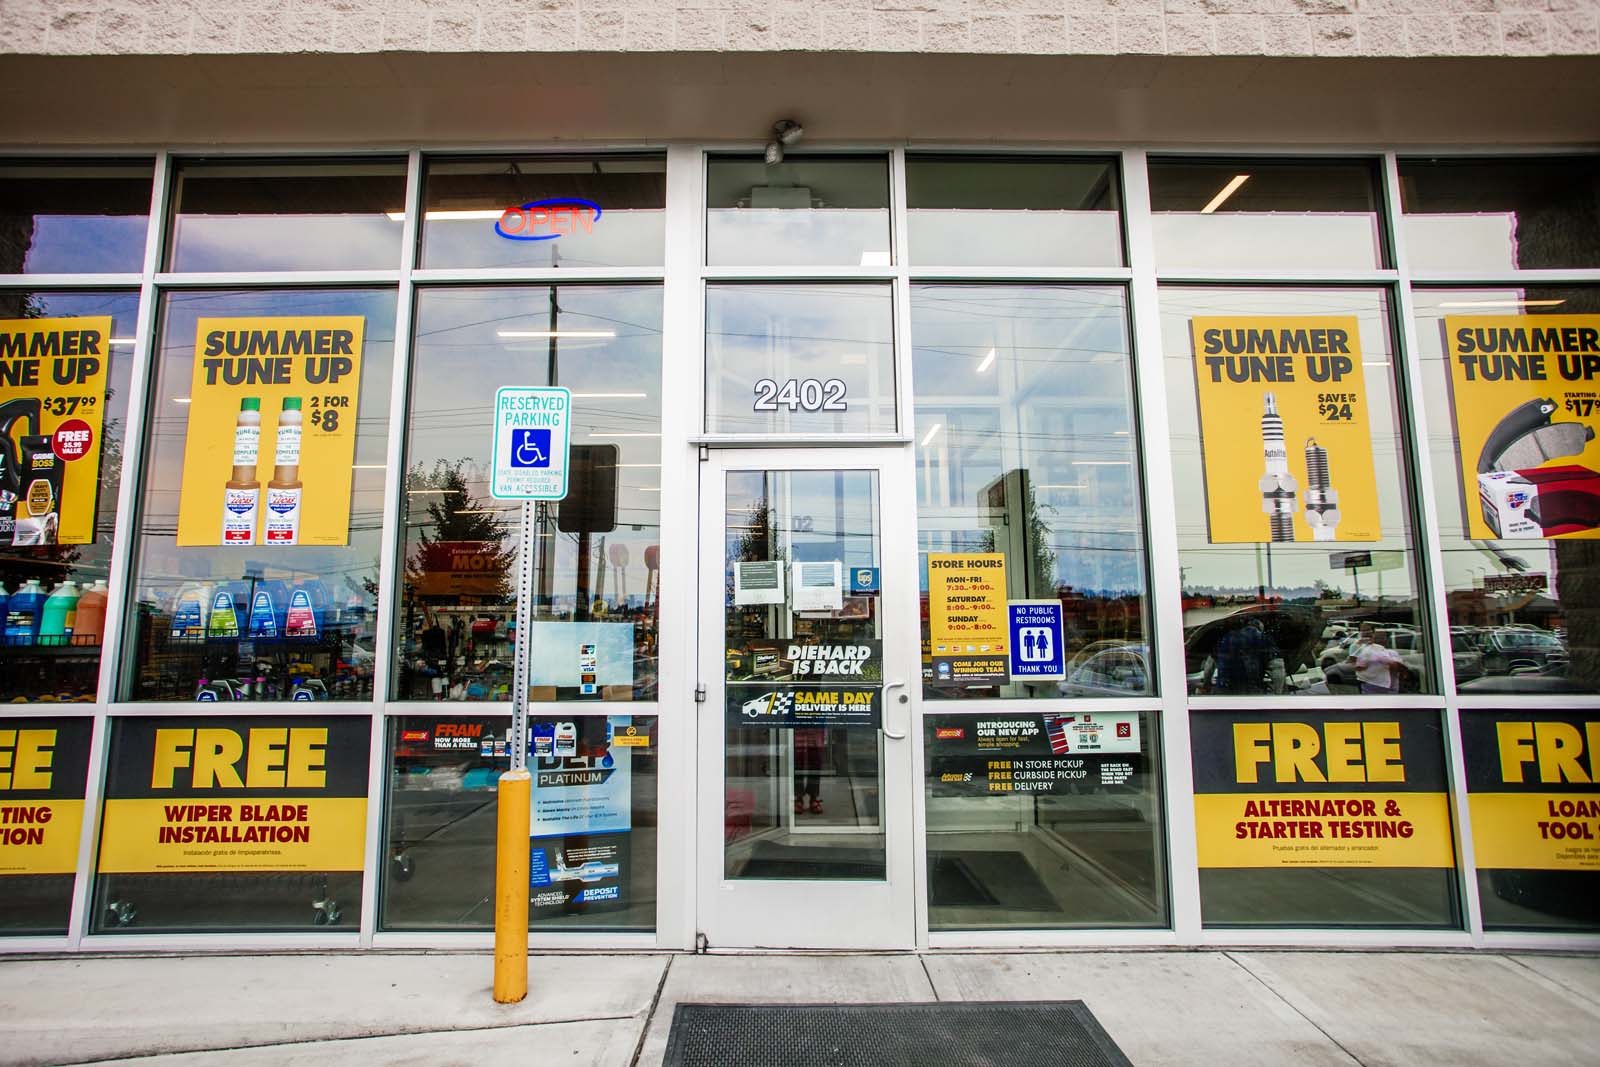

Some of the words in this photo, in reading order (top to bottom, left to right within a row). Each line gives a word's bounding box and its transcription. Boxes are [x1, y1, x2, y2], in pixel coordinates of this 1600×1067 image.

[500, 207, 593, 234] OPEN
[204, 330, 354, 356] SUMMER
[1204, 329, 1350, 354] SUMMER
[1457, 328, 1600, 353] SUMMER
[53, 358, 100, 384] UP
[203, 357, 292, 385] TUNE
[305, 357, 353, 384] UP
[1205, 356, 1295, 383] TUNE
[1306, 356, 1352, 382] UP
[1459, 355, 1547, 381] TUNE
[1559, 355, 1600, 381] UP
[311, 396, 320, 407] 2
[323, 396, 350, 407] FOR
[754, 379, 847, 411] 2402
[1318, 393, 1347, 402] SAVE
[501, 397, 564, 410] RESERVED
[505, 412, 560, 426] PARKING
[1318, 403, 1353, 421] $24
[311, 409, 339, 432] $8
[57, 430, 90, 443] FREE
[32, 459, 54, 467] BOSS
[516, 484, 558, 492] ACCESSIBLE
[931, 560, 964, 568] STORE
[967, 560, 1003, 568] HOURS
[1015, 616, 1056, 624] RESTROOMS
[787, 645, 871, 660] DIEHARD
[792, 660, 810, 674] IS
[813, 660, 865, 674] BACK
[1017, 665, 1040, 673] THANK
[1043, 665, 1058, 673] YOU
[795, 692, 838, 704] SAME
[843, 692, 874, 704] DAY
[434, 723, 482, 737] FRAM
[977, 721, 1035, 729] INTRODUCING
[152, 728, 328, 789] FREE
[1232, 722, 1405, 783] FREE
[988, 761, 1011, 769] FREE
[1013, 761, 1023, 769] IN
[1025, 760, 1052, 769] STORE
[1054, 760, 1084, 768] PICKUP
[540, 773, 602, 785] PLATINUM
[988, 771, 1012, 780] FREE
[1013, 771, 1055, 779] CURBSIDE
[1057, 770, 1087, 779] PICKUP
[988, 783, 1012, 791] FREE
[1014, 782, 1053, 790] DELIVERY
[164, 805, 233, 822] WIPER
[240, 804, 308, 822] BLADE
[1244, 800, 1377, 817] ALTERNATOR
[1384, 799, 1402, 817] &
[1, 807, 52, 824] TING
[0, 828, 44, 845] ION
[159, 826, 310, 844] INSTALLATION
[1235, 821, 1324, 839] STARTER
[1328, 821, 1414, 839] TESTING
[1538, 821, 1594, 840] TOOL
[583, 886, 618, 896] DEPOSIT
[583, 893, 618, 901] PREVENTION
[535, 899, 565, 907] TECHNOLOGY
